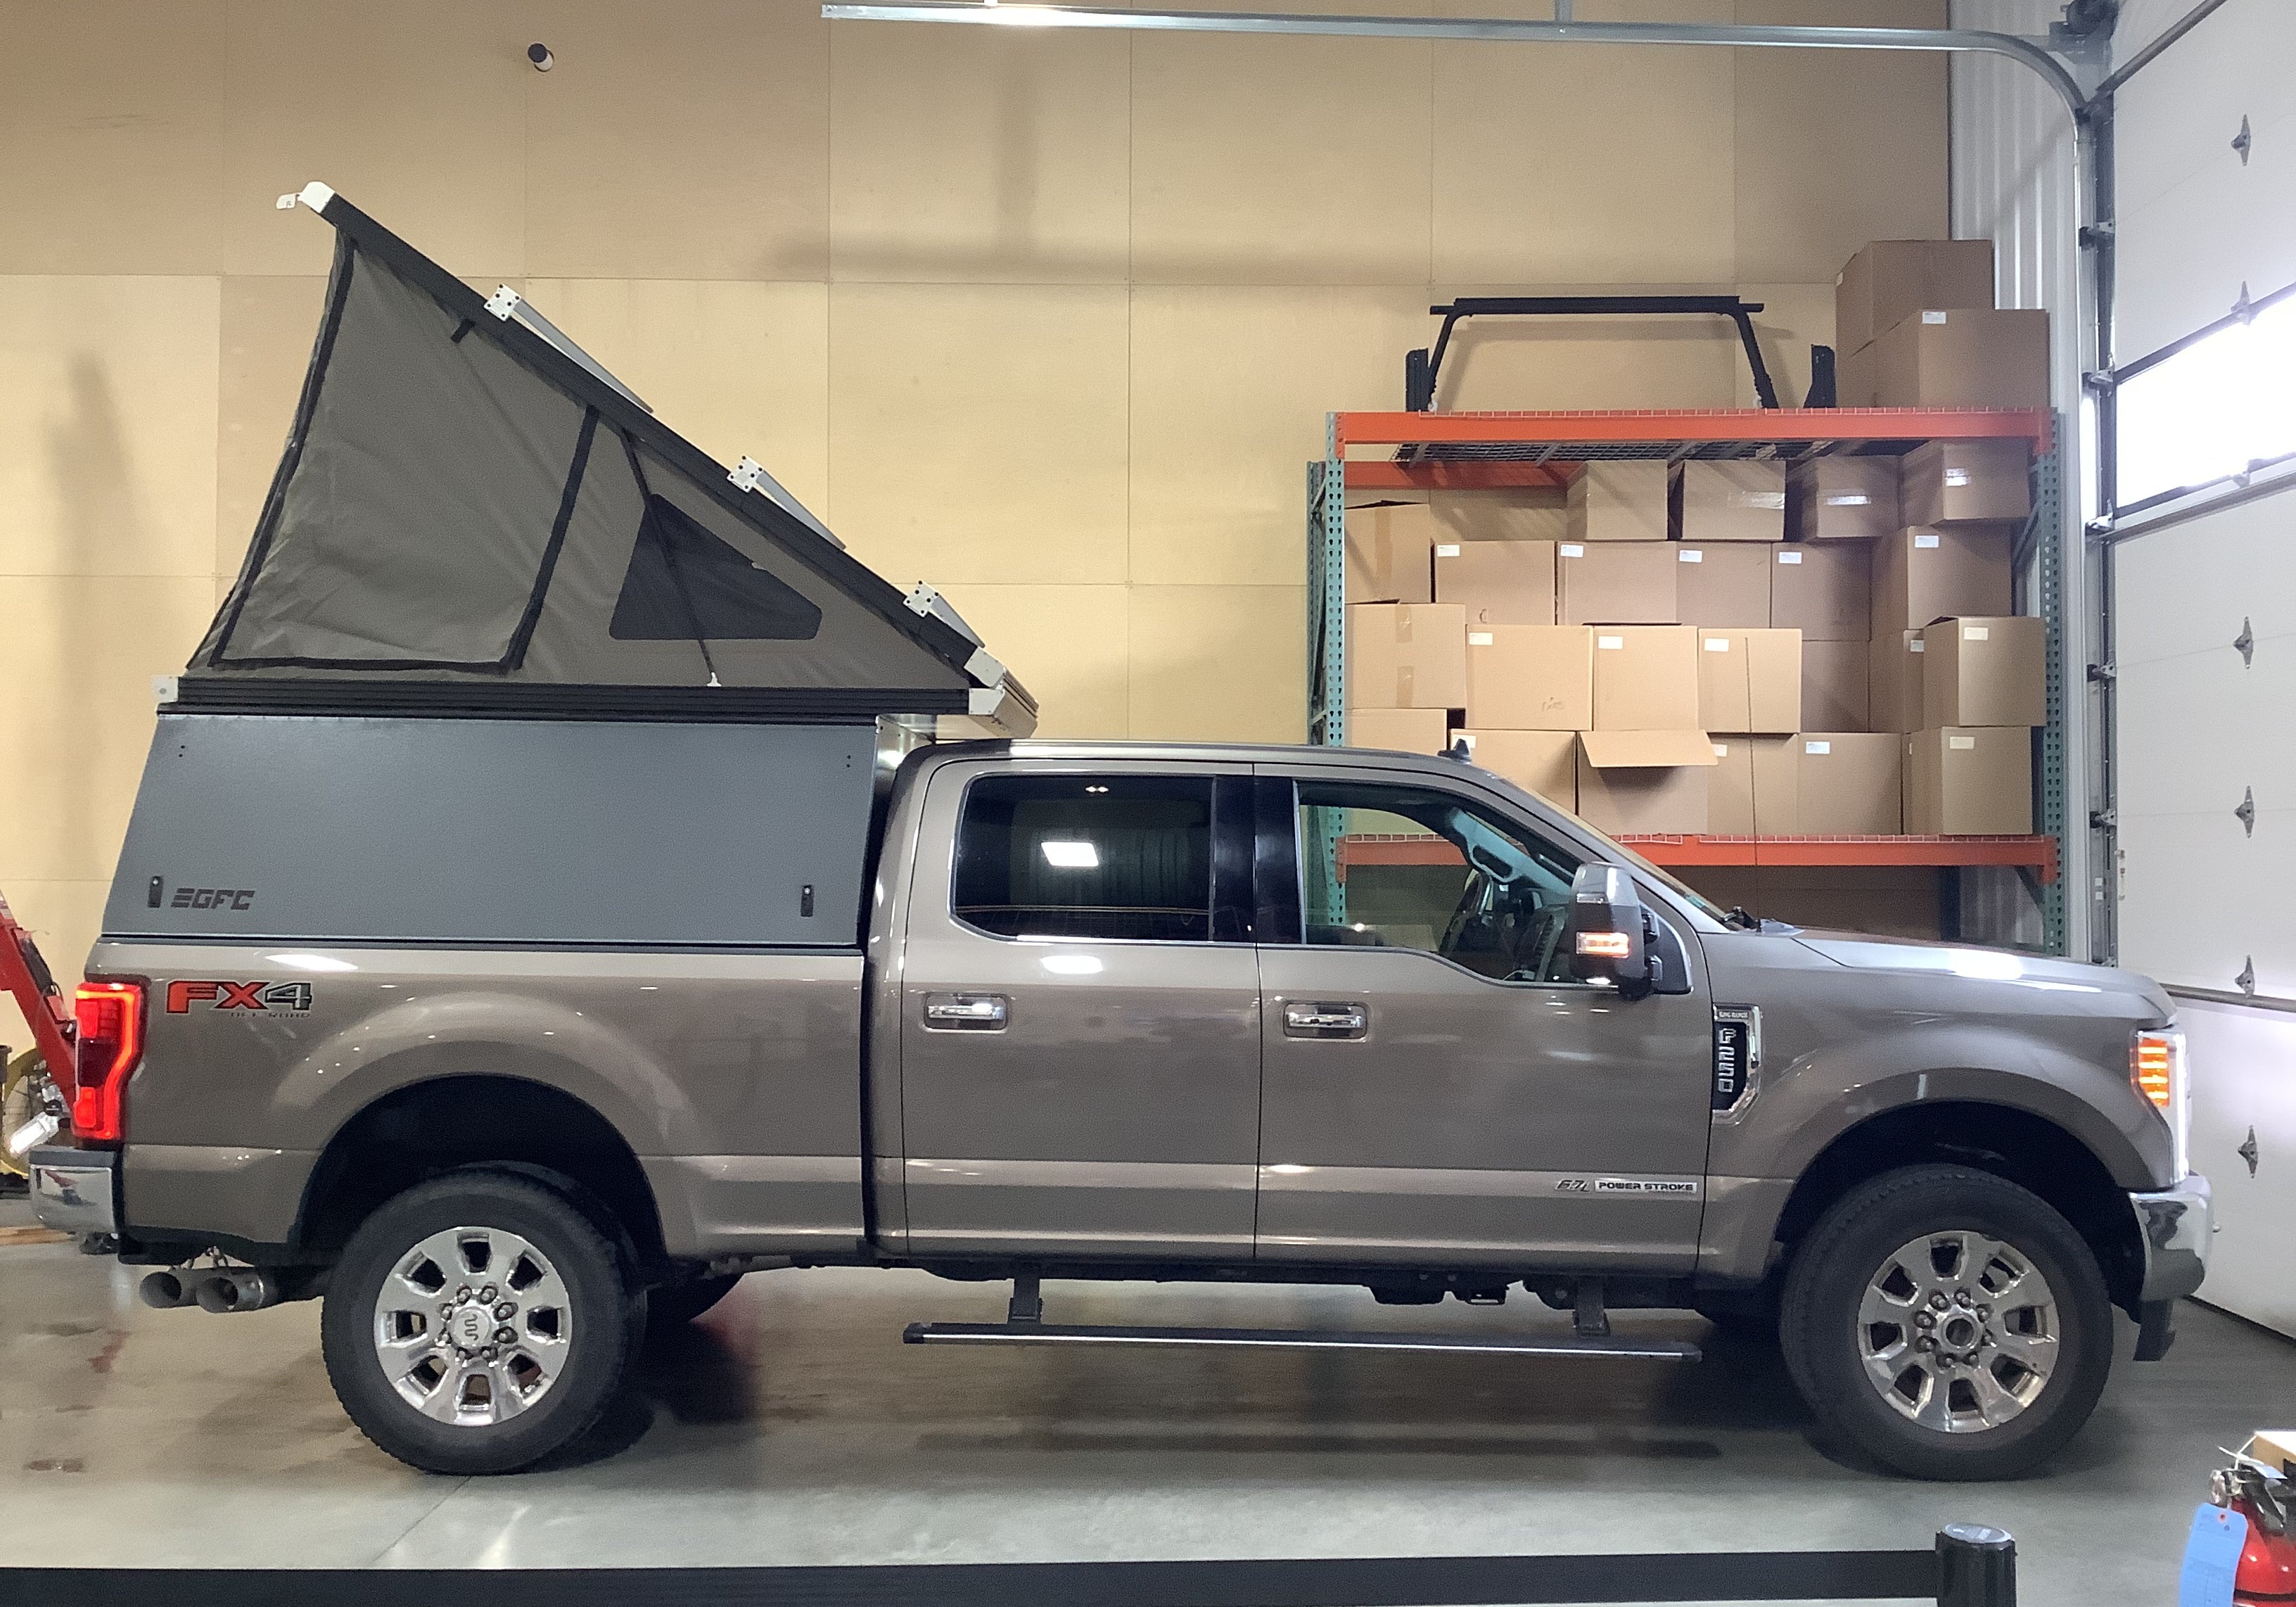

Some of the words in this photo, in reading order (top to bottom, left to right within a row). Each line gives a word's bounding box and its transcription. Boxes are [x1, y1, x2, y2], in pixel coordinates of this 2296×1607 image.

[166, 981, 312, 1014] FX4
[1598, 1181, 1642, 1190] POWER
[1643, 1182, 1694, 1191] STROKE
